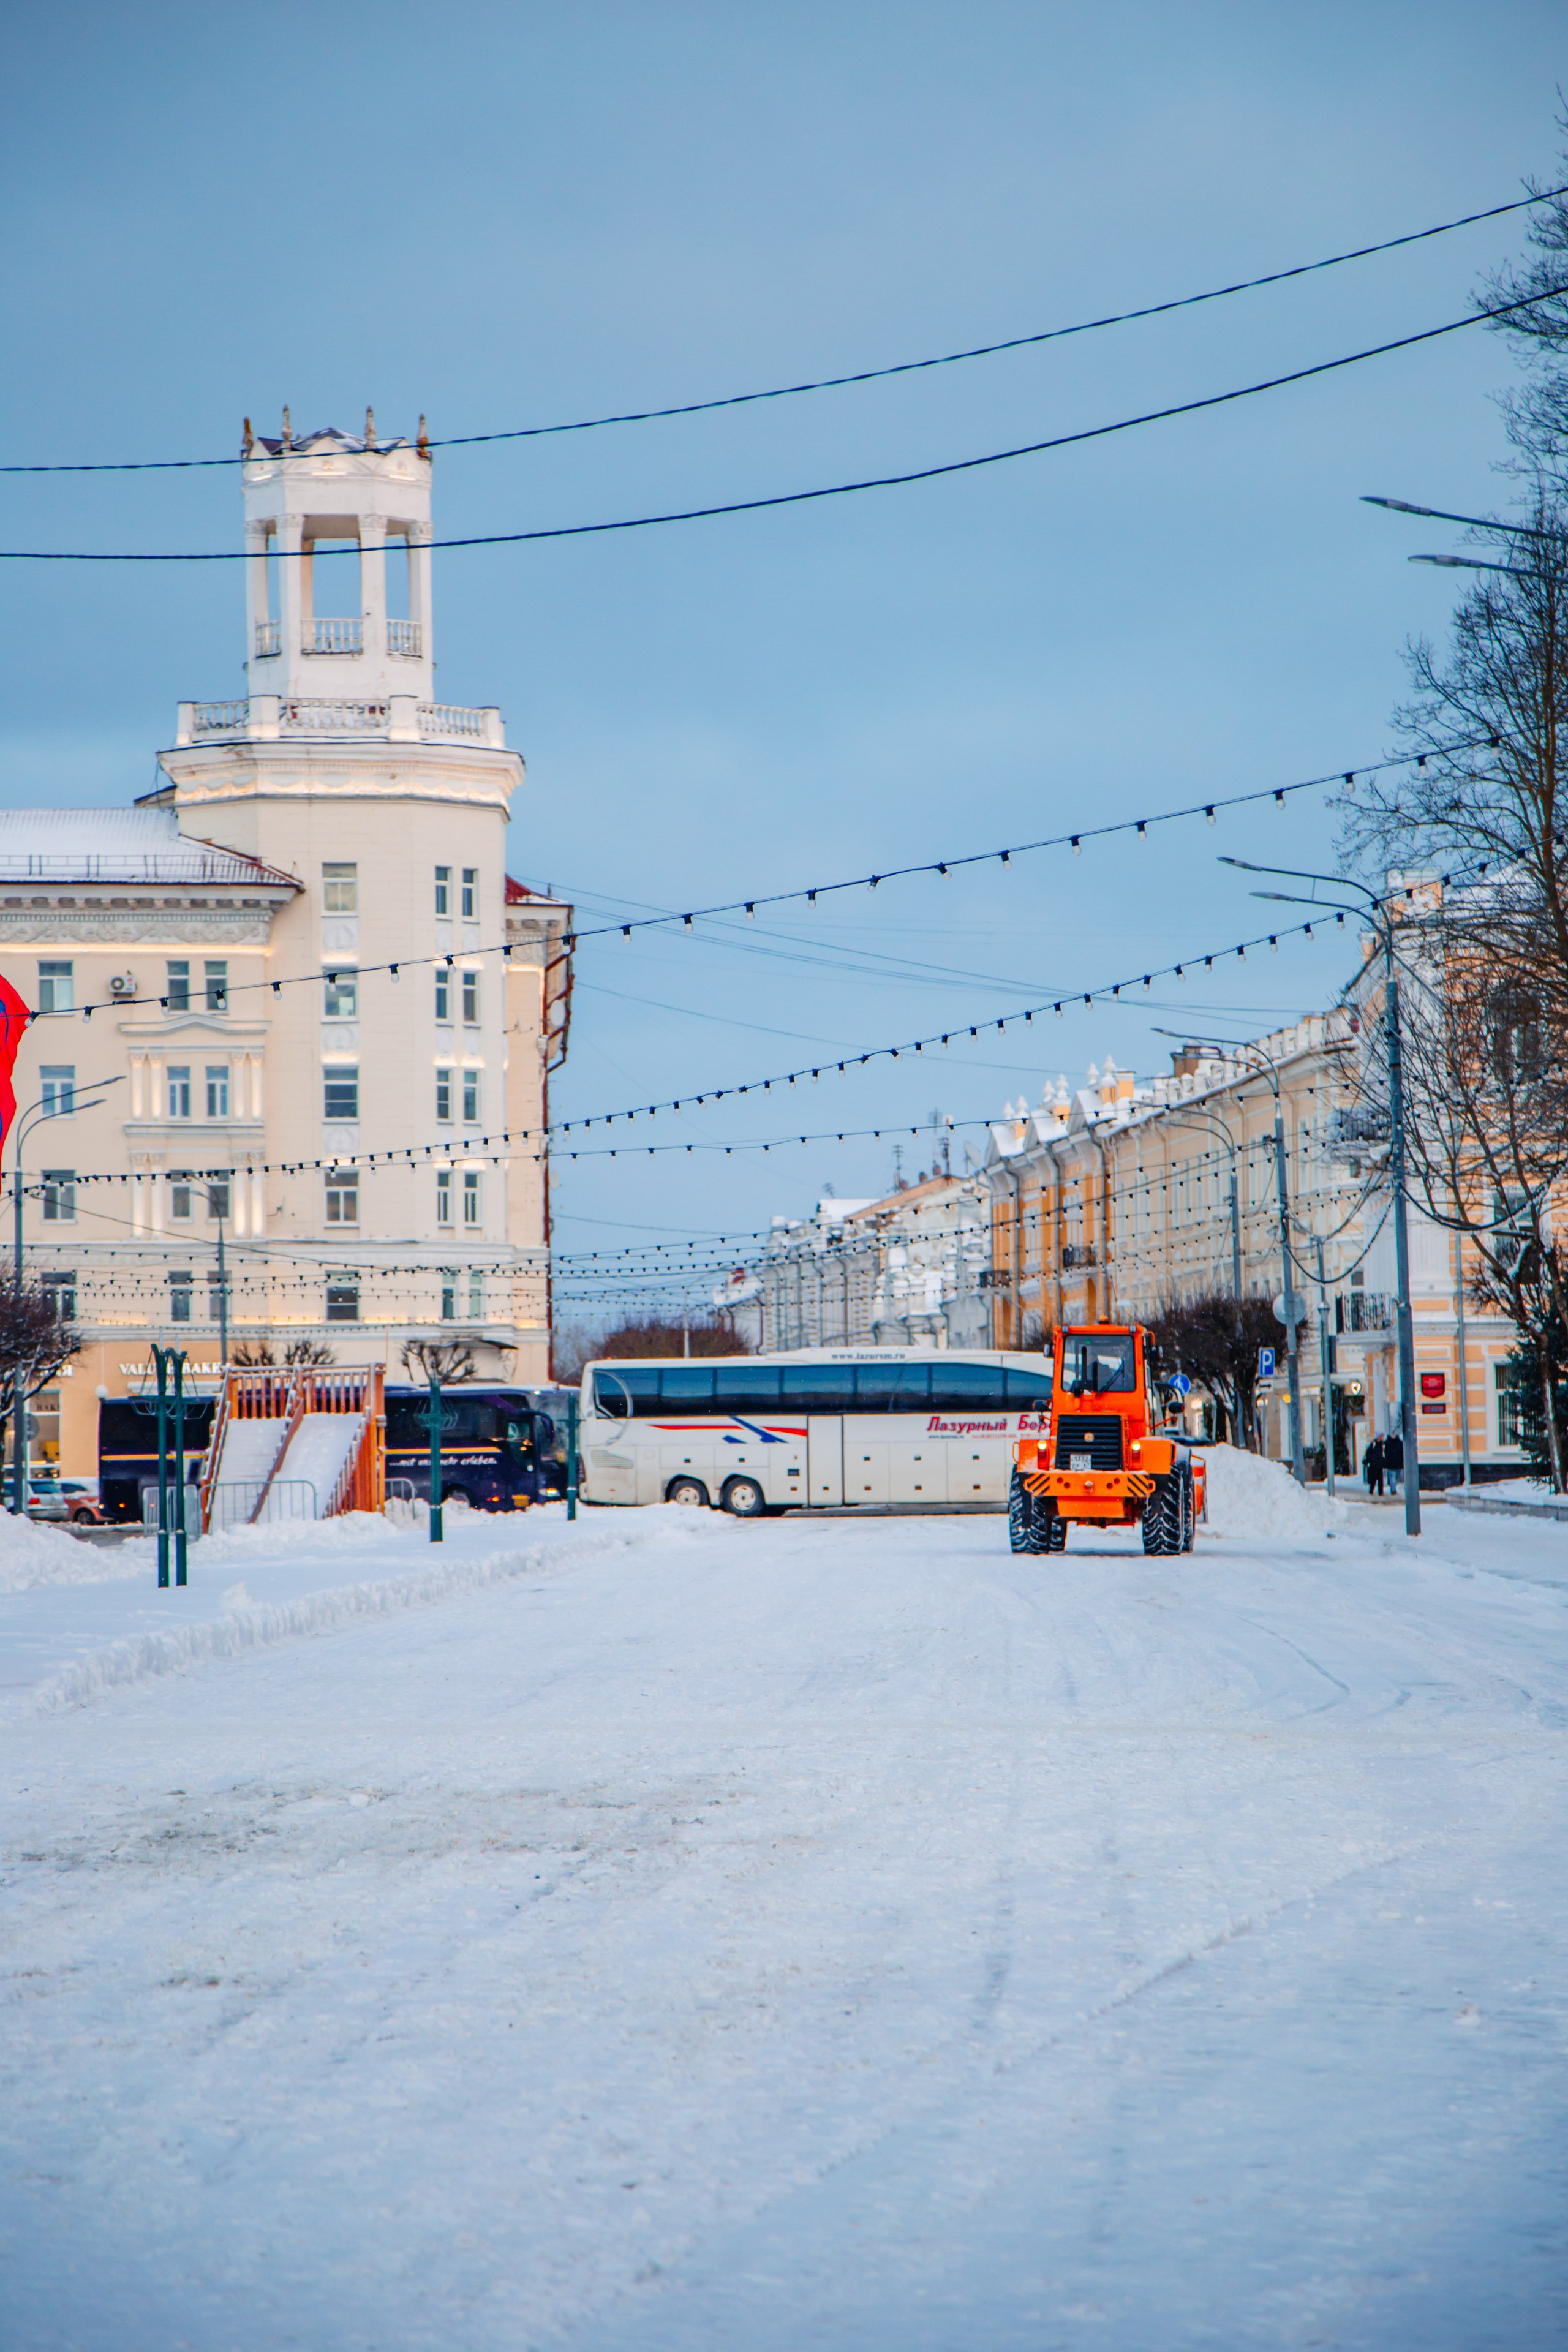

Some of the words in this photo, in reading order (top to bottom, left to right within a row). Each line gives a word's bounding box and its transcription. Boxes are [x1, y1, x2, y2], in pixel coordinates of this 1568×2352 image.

[1262, 1351, 1272, 1374] P
[927, 1416, 1008, 1434] Лазурный
[1018, 1414, 1052, 1433] Бер
